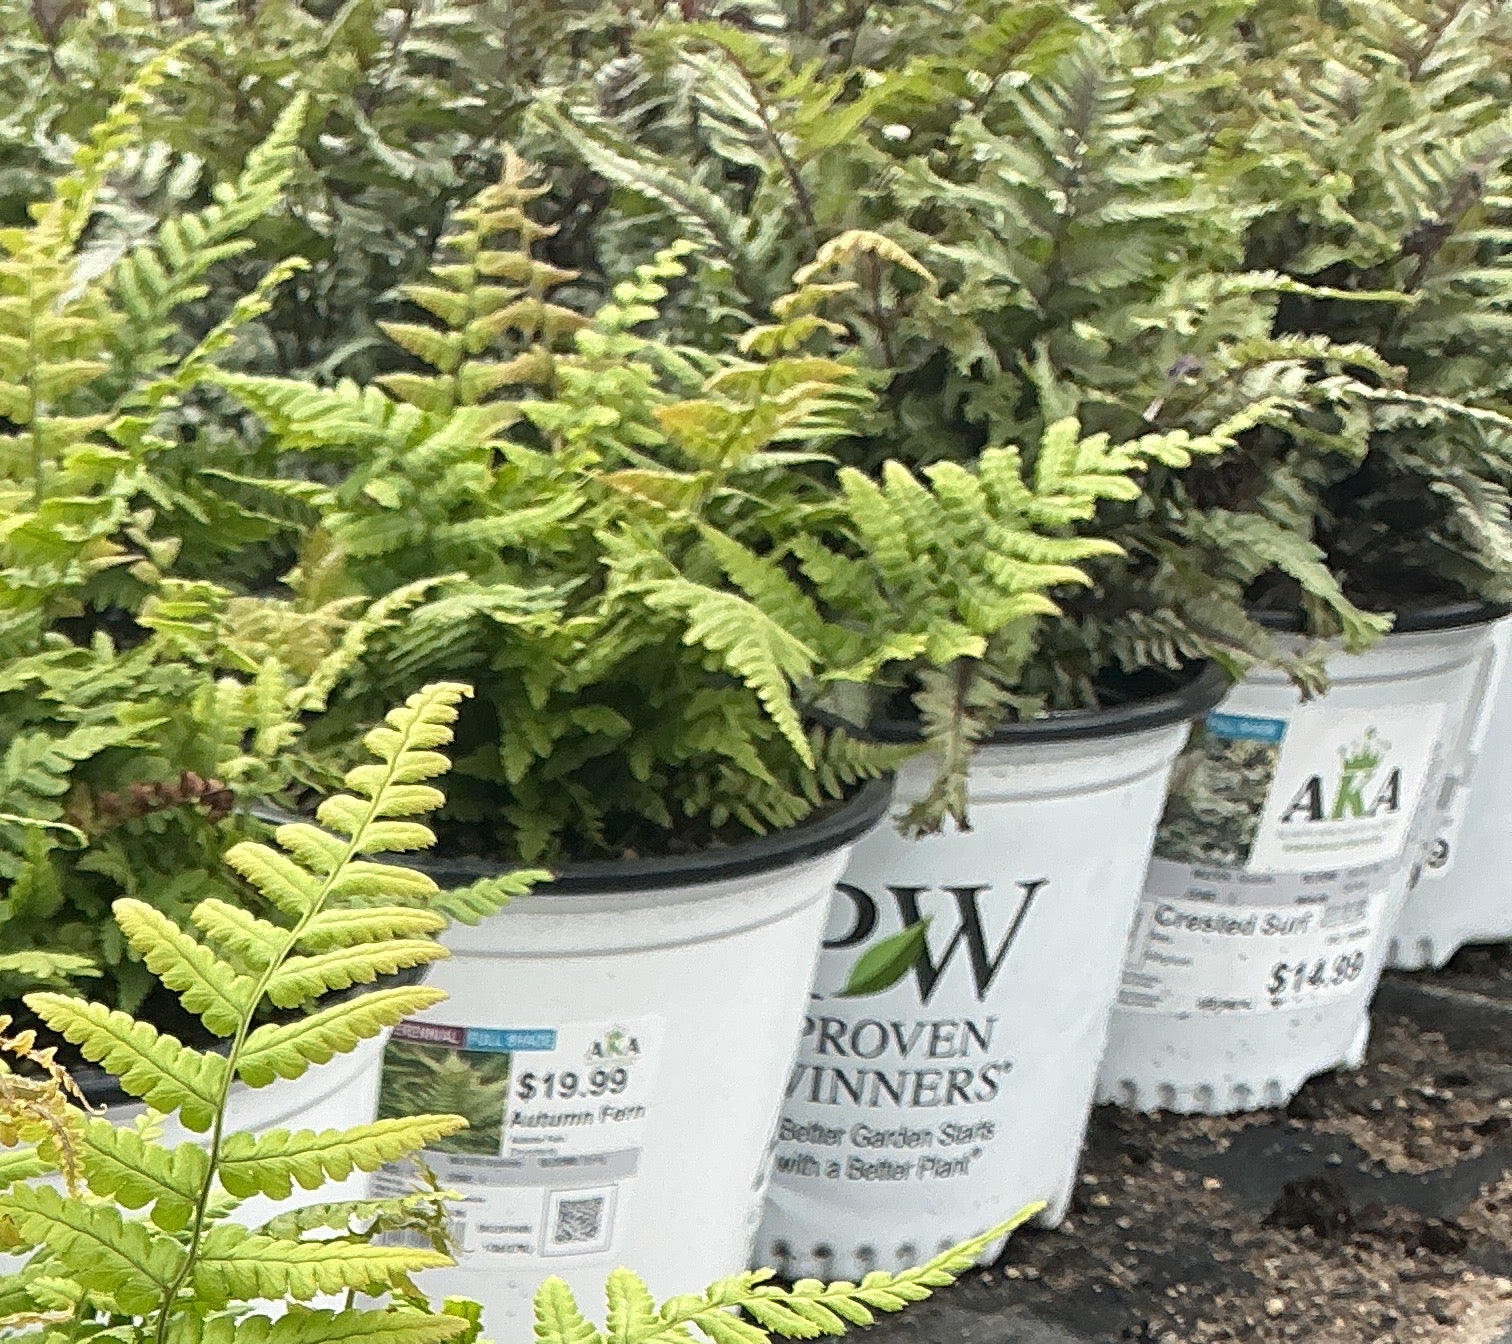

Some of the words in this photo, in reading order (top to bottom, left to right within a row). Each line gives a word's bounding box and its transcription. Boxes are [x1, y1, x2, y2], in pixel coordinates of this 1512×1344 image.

[1279, 767, 1402, 824] AKA
[1155, 904, 1257, 935] Crested
[1259, 909, 1316, 935] Surf
[517, 1067, 629, 1101] $19.99
[510, 1109, 594, 1129] Autumn
[600, 1103, 646, 1122] Fern
[778, 1118, 845, 1145] Better
[850, 1121, 933, 1148] Garden
[775, 1153, 821, 1179] with
[825, 1159, 841, 1179] a
[845, 1155, 914, 1181] Better
